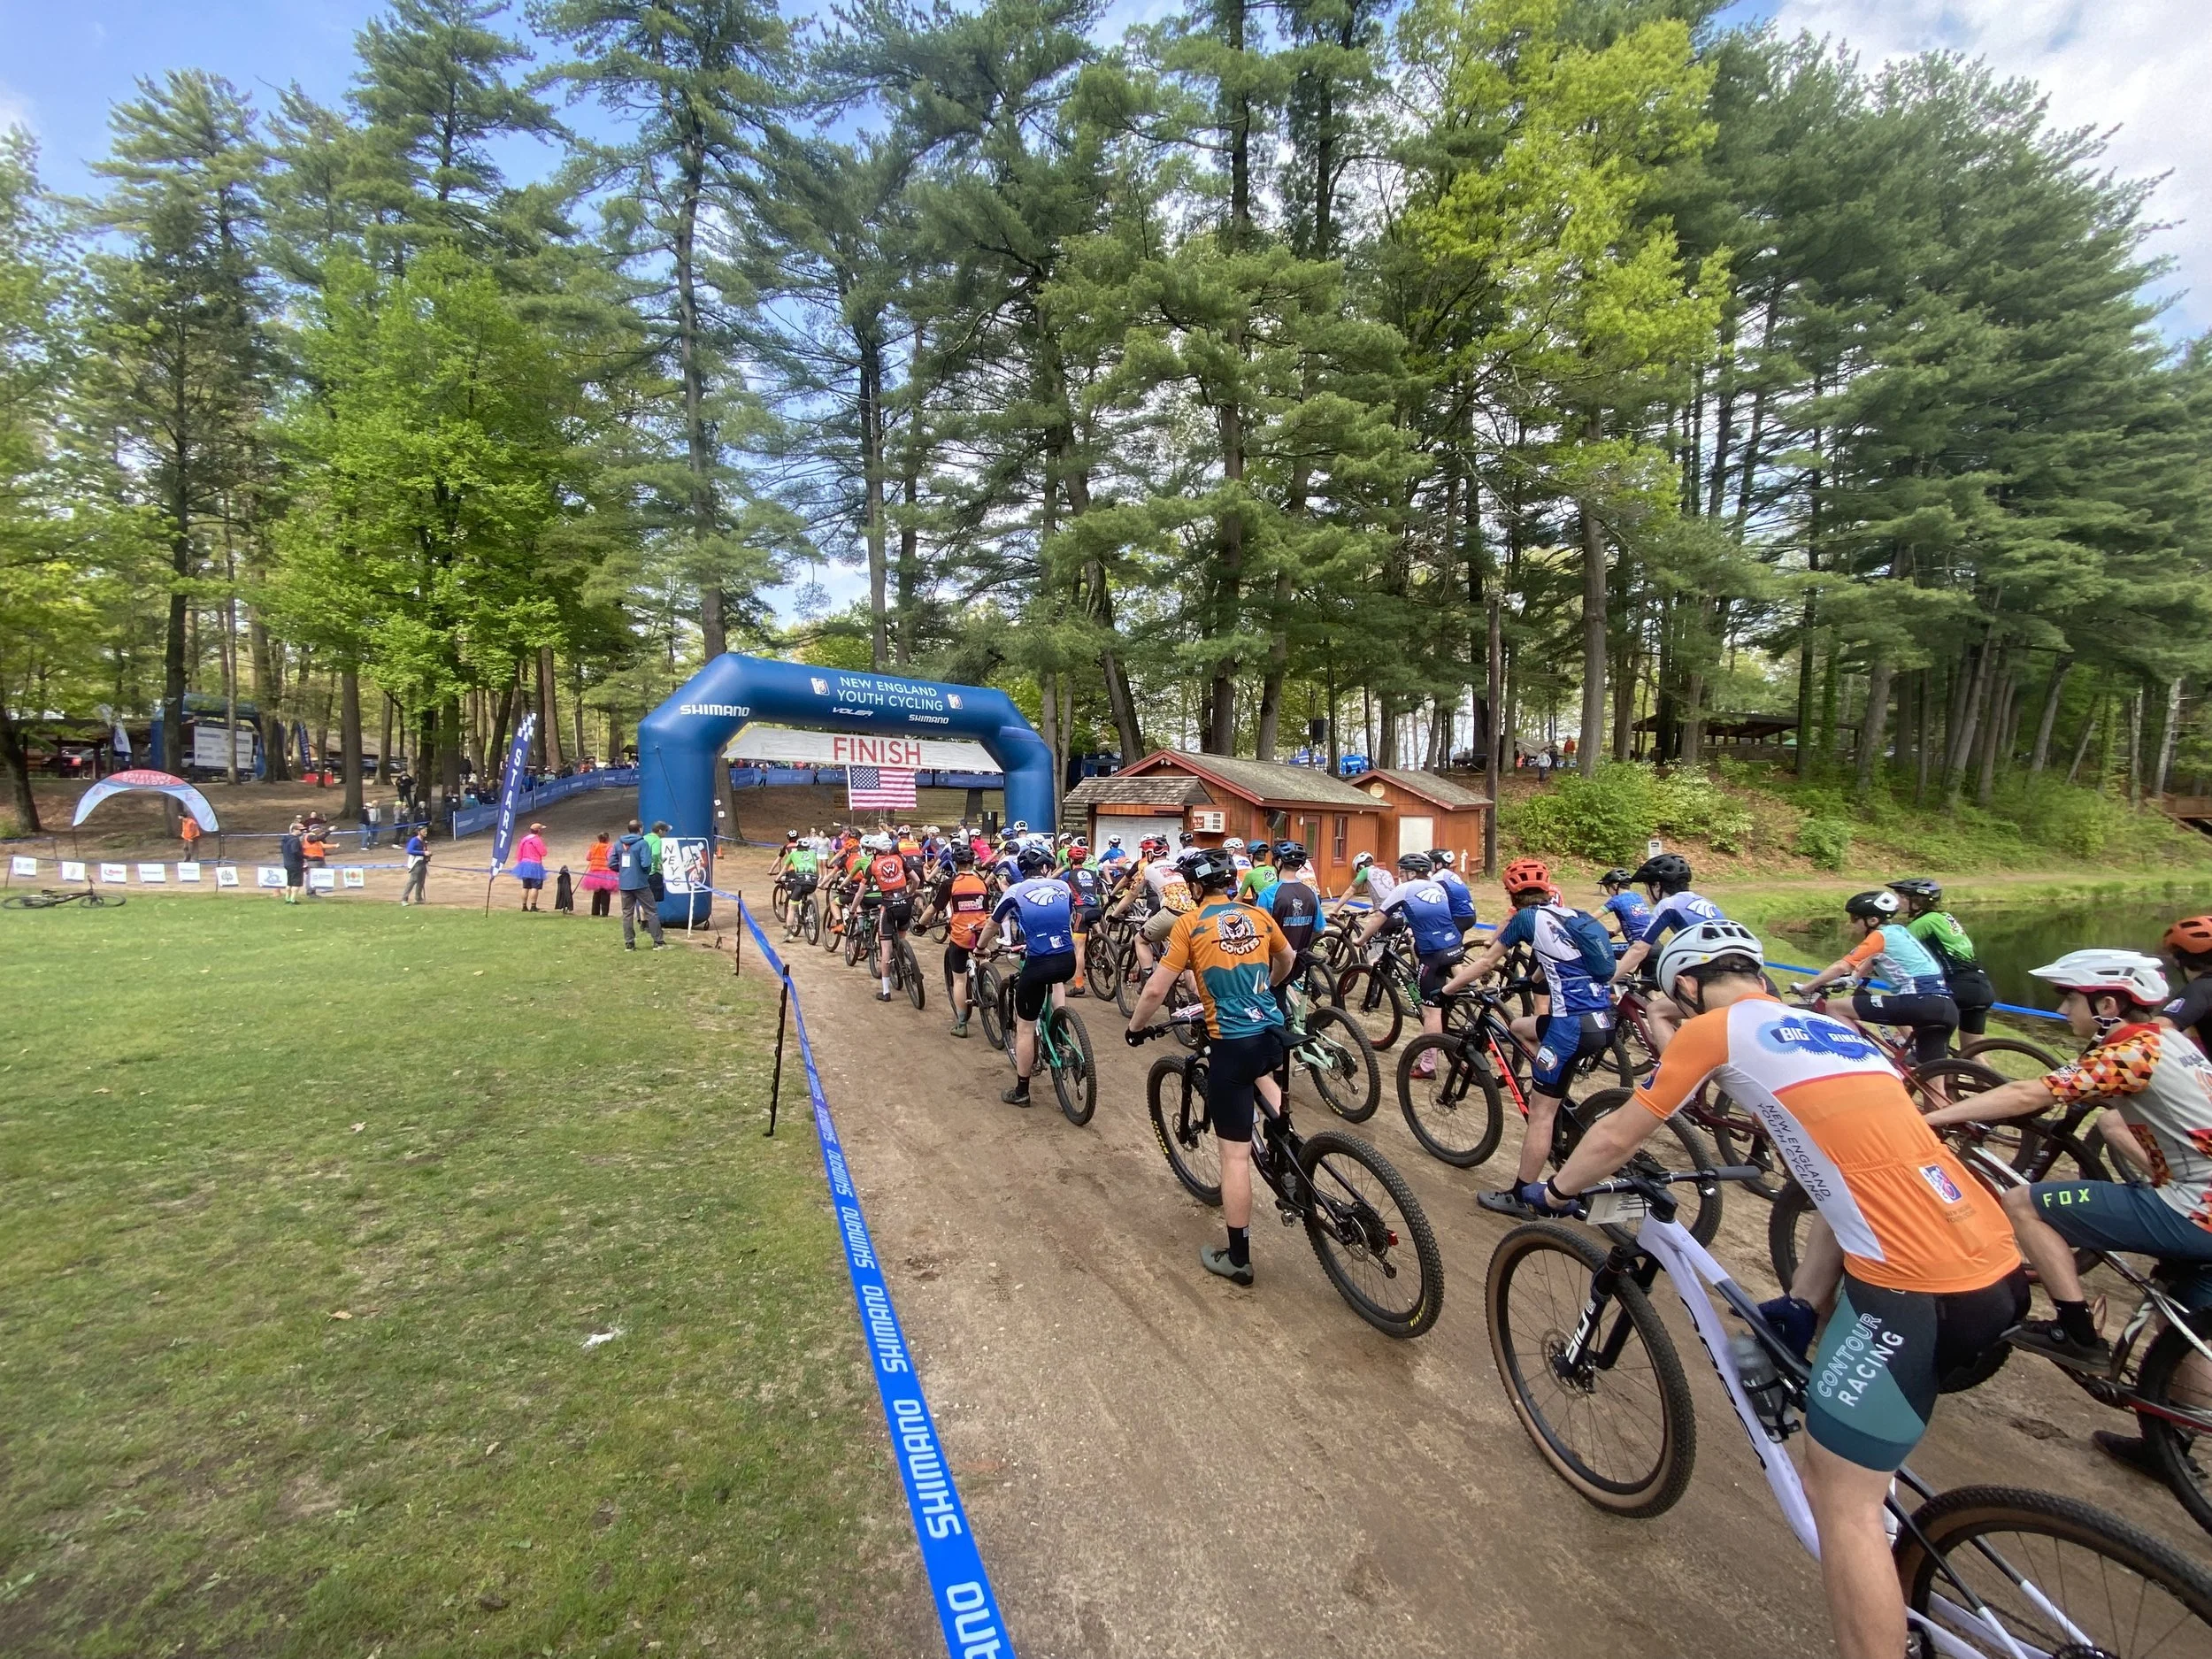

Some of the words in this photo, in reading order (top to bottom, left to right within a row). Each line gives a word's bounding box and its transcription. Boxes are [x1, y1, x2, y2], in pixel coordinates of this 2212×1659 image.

[837, 689, 884, 705] YOUTH
[888, 695, 943, 711] CYCLING
[840, 677, 872, 689] NEW
[876, 681, 937, 697] ENGLAND
[680, 704, 750, 718] SHIMANO
[833, 707, 873, 717] VOLER
[909, 714, 949, 724] SHIMANO
[833, 737, 921, 765] FINISH
[499, 748, 522, 849] START
[1778, 1027, 1810, 1041] BIG
[816, 1105, 836, 1144] SHIMANO
[827, 1148, 853, 1198] SHIMANO
[1757, 1103, 1787, 1143] YOUTH
[1786, 1148, 1824, 1202] CYCLING
[1766, 1105, 1792, 1133] NEW
[1787, 1137, 1831, 1197] ENGLAND
[2042, 1188, 2090, 1208] FOX
[841, 1206, 875, 1270] SHIMANO
[862, 1285, 909, 1373] SHIMANO
[1816, 1313, 1882, 1398] CONTOUR
[1838, 1331, 1904, 1407] RACING
[893, 1399, 963, 1539] SHIMANO
